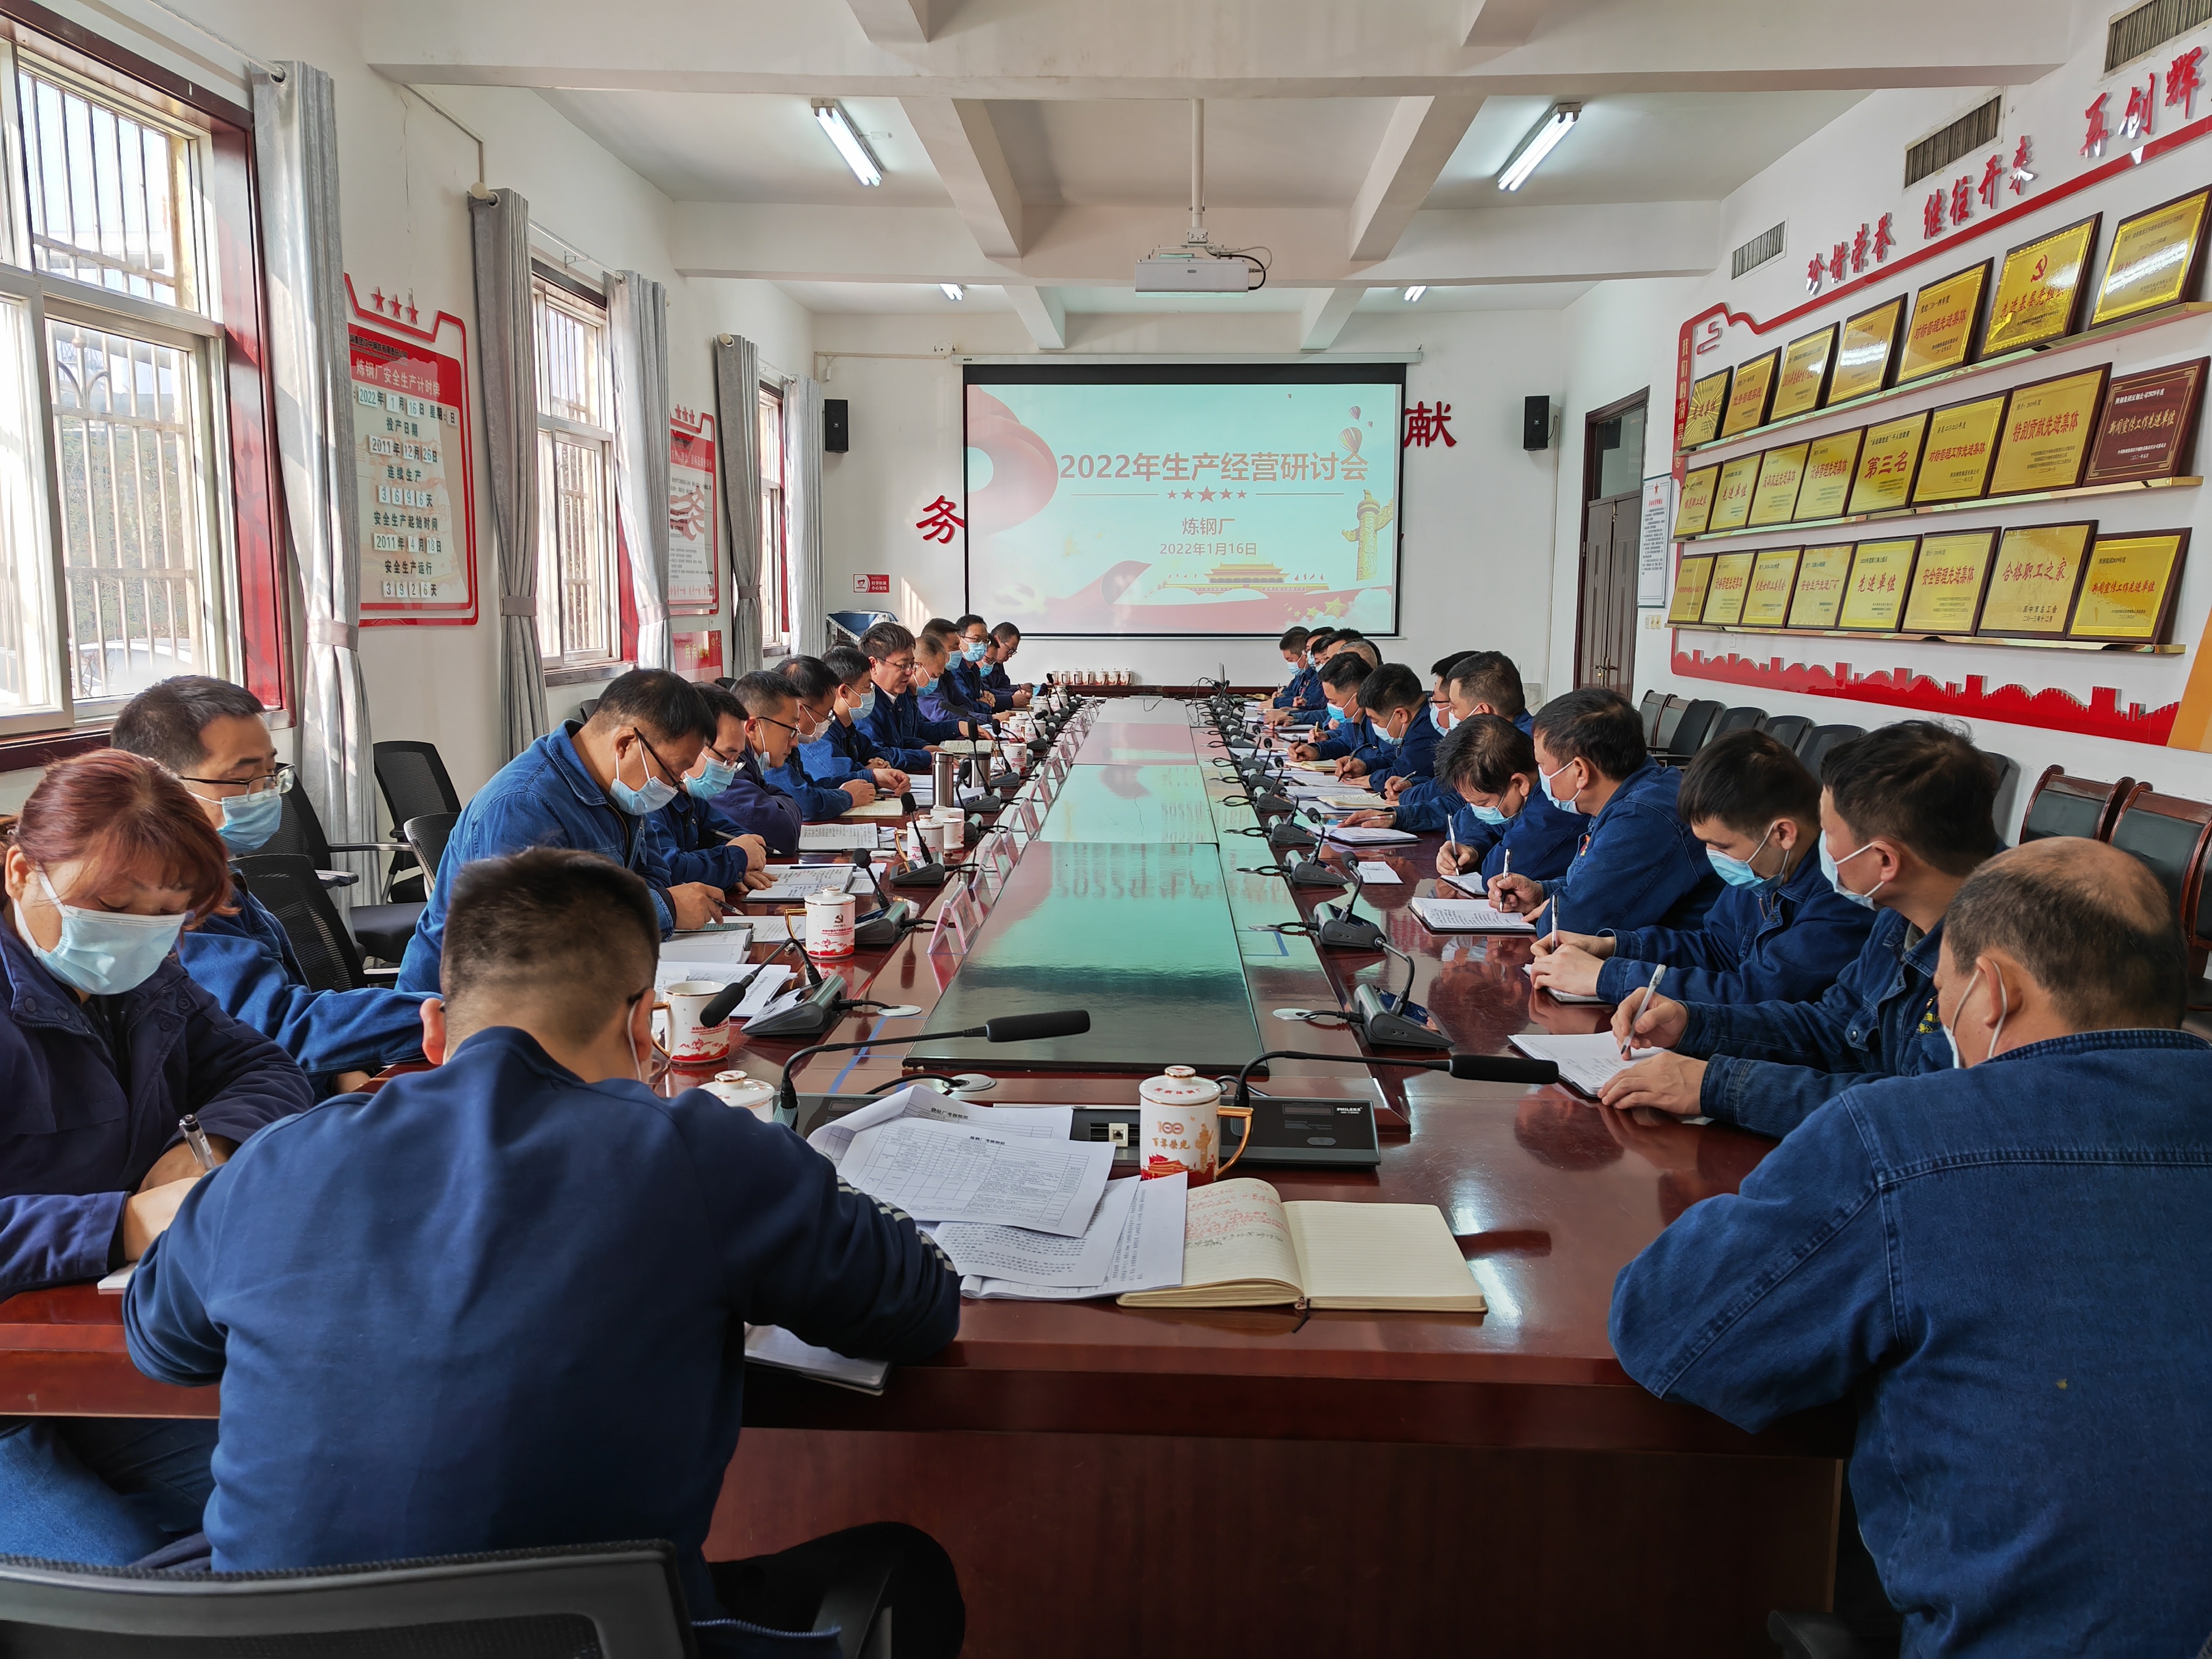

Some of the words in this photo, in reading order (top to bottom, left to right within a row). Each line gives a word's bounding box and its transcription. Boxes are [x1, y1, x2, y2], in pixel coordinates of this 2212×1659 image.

[1806, 213, 1892, 295] 珍惜荣誉
[1923, 136, 2038, 240] 继往开来
[1914, 308, 1967, 339] 对标管理先进集体
[356, 358, 441, 397] 炼钢厂安全生产计时牌
[386, 417, 418, 437] 投产日期
[1404, 401, 1457, 448] 献
[2013, 410, 2079, 441] 特别贡献先进集体
[2108, 408, 2176, 436] 新闻宣传工作先进单位
[1930, 442, 1985, 461] 对标管理工作先进集体
[387, 465, 422, 482] 连续生产
[1060, 451, 1368, 482] 2022年生产经营研讨会
[1864, 449, 1909, 478] 第三名
[1721, 481, 1748, 502] 先进单位
[374, 511, 438, 531] 安全生产起始时间
[916, 495, 965, 544] 务
[1182, 517, 1236, 536] 炼钢厂
[1160, 542, 1257, 557] 2022年1月16日
[385, 559, 432, 575] 安全生产运行
[1922, 565, 1975, 584] 安全管理先进集体
[2002, 558, 2067, 580] 合格职工之家
[1857, 572, 1898, 593] 先进单位
[2092, 579, 2155, 593] 新闻宣传工作先进单位
[2024, 605, 2057, 613] 汉中市总工会
[1152, 1137, 1190, 1150] 百年荣光
